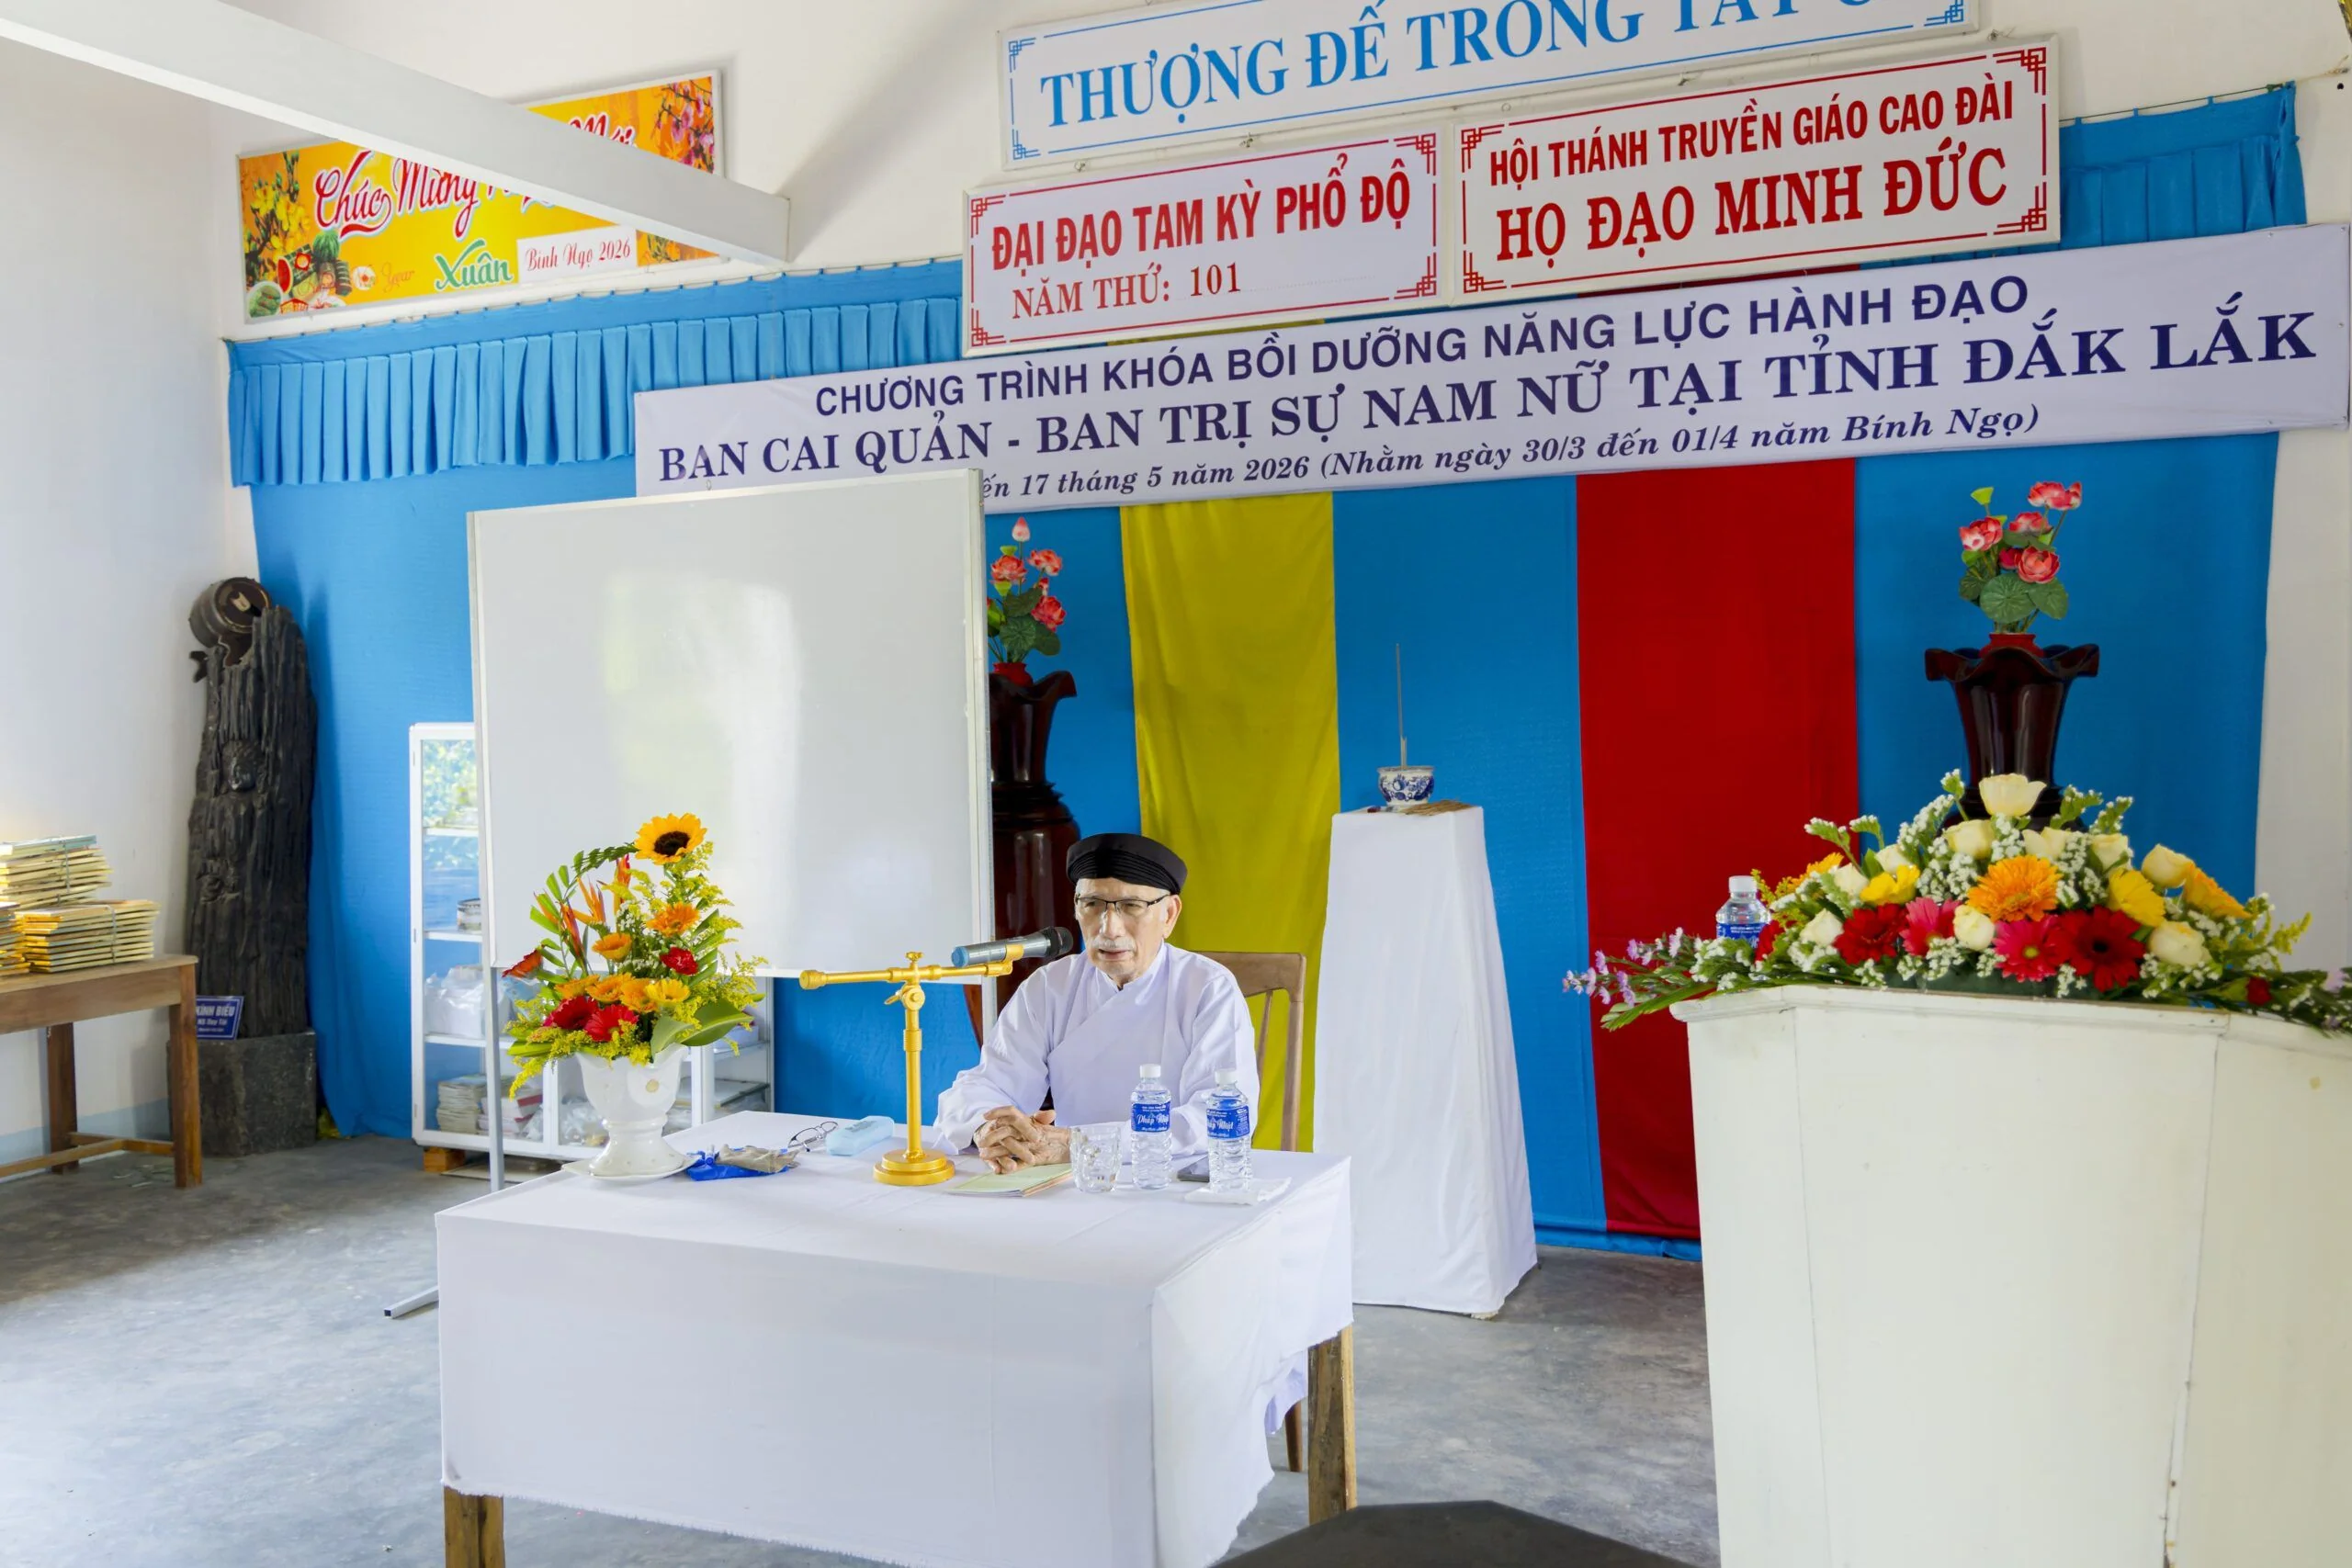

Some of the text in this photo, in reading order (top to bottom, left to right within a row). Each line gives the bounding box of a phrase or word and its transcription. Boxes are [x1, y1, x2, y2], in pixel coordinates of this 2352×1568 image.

[1041, 0, 1641, 126] THƯỢNG ĐẾ TRONG
[1491, 73, 2012, 189] HỘI THÁNH TRUYỀN GIÁO CAO ĐÀI
[316, 152, 389, 237] Chúc
[992, 153, 1409, 276] ĐẠI ĐẠO TAM KỲ PHỔ ĐỘ
[1497, 137, 2006, 268] HỌ ĐẠO MINH ĐỨC
[435, 239, 511, 289] Xuân
[563, 243, 594, 269] Ngọ
[598, 239, 631, 262] 2026
[1012, 262, 1241, 319] NĂM THỨ: 101
[660, 442, 748, 480] BAN
[763, 434, 839, 472] CAI
[855, 411, 991, 473] QUẢN
[1036, 410, 1143, 453] BAN
[1159, 400, 1251, 448] TRỊ
[1272, 383, 1345, 443] SỰ
[1363, 380, 1497, 428] NAM
[1517, 359, 1609, 417] NỮ
[1630, 360, 1742, 415] TẠI
[1765, 334, 1939, 398] TỈNH
[1963, 308, 2126, 383] ĐẮK
[2150, 291, 2316, 369] LẮK
[817, 276, 2028, 416] CHƯƠNG TRÌNH KHÓA BỒI DƯỠNG NĂNG LỰC HÀNH ĐẠO
[982, 404, 2038, 498] ến 17 tháng 5 năm 2026 (Nhằm ngày 30/3 đến 01/4 năm Bính Ngọ)
